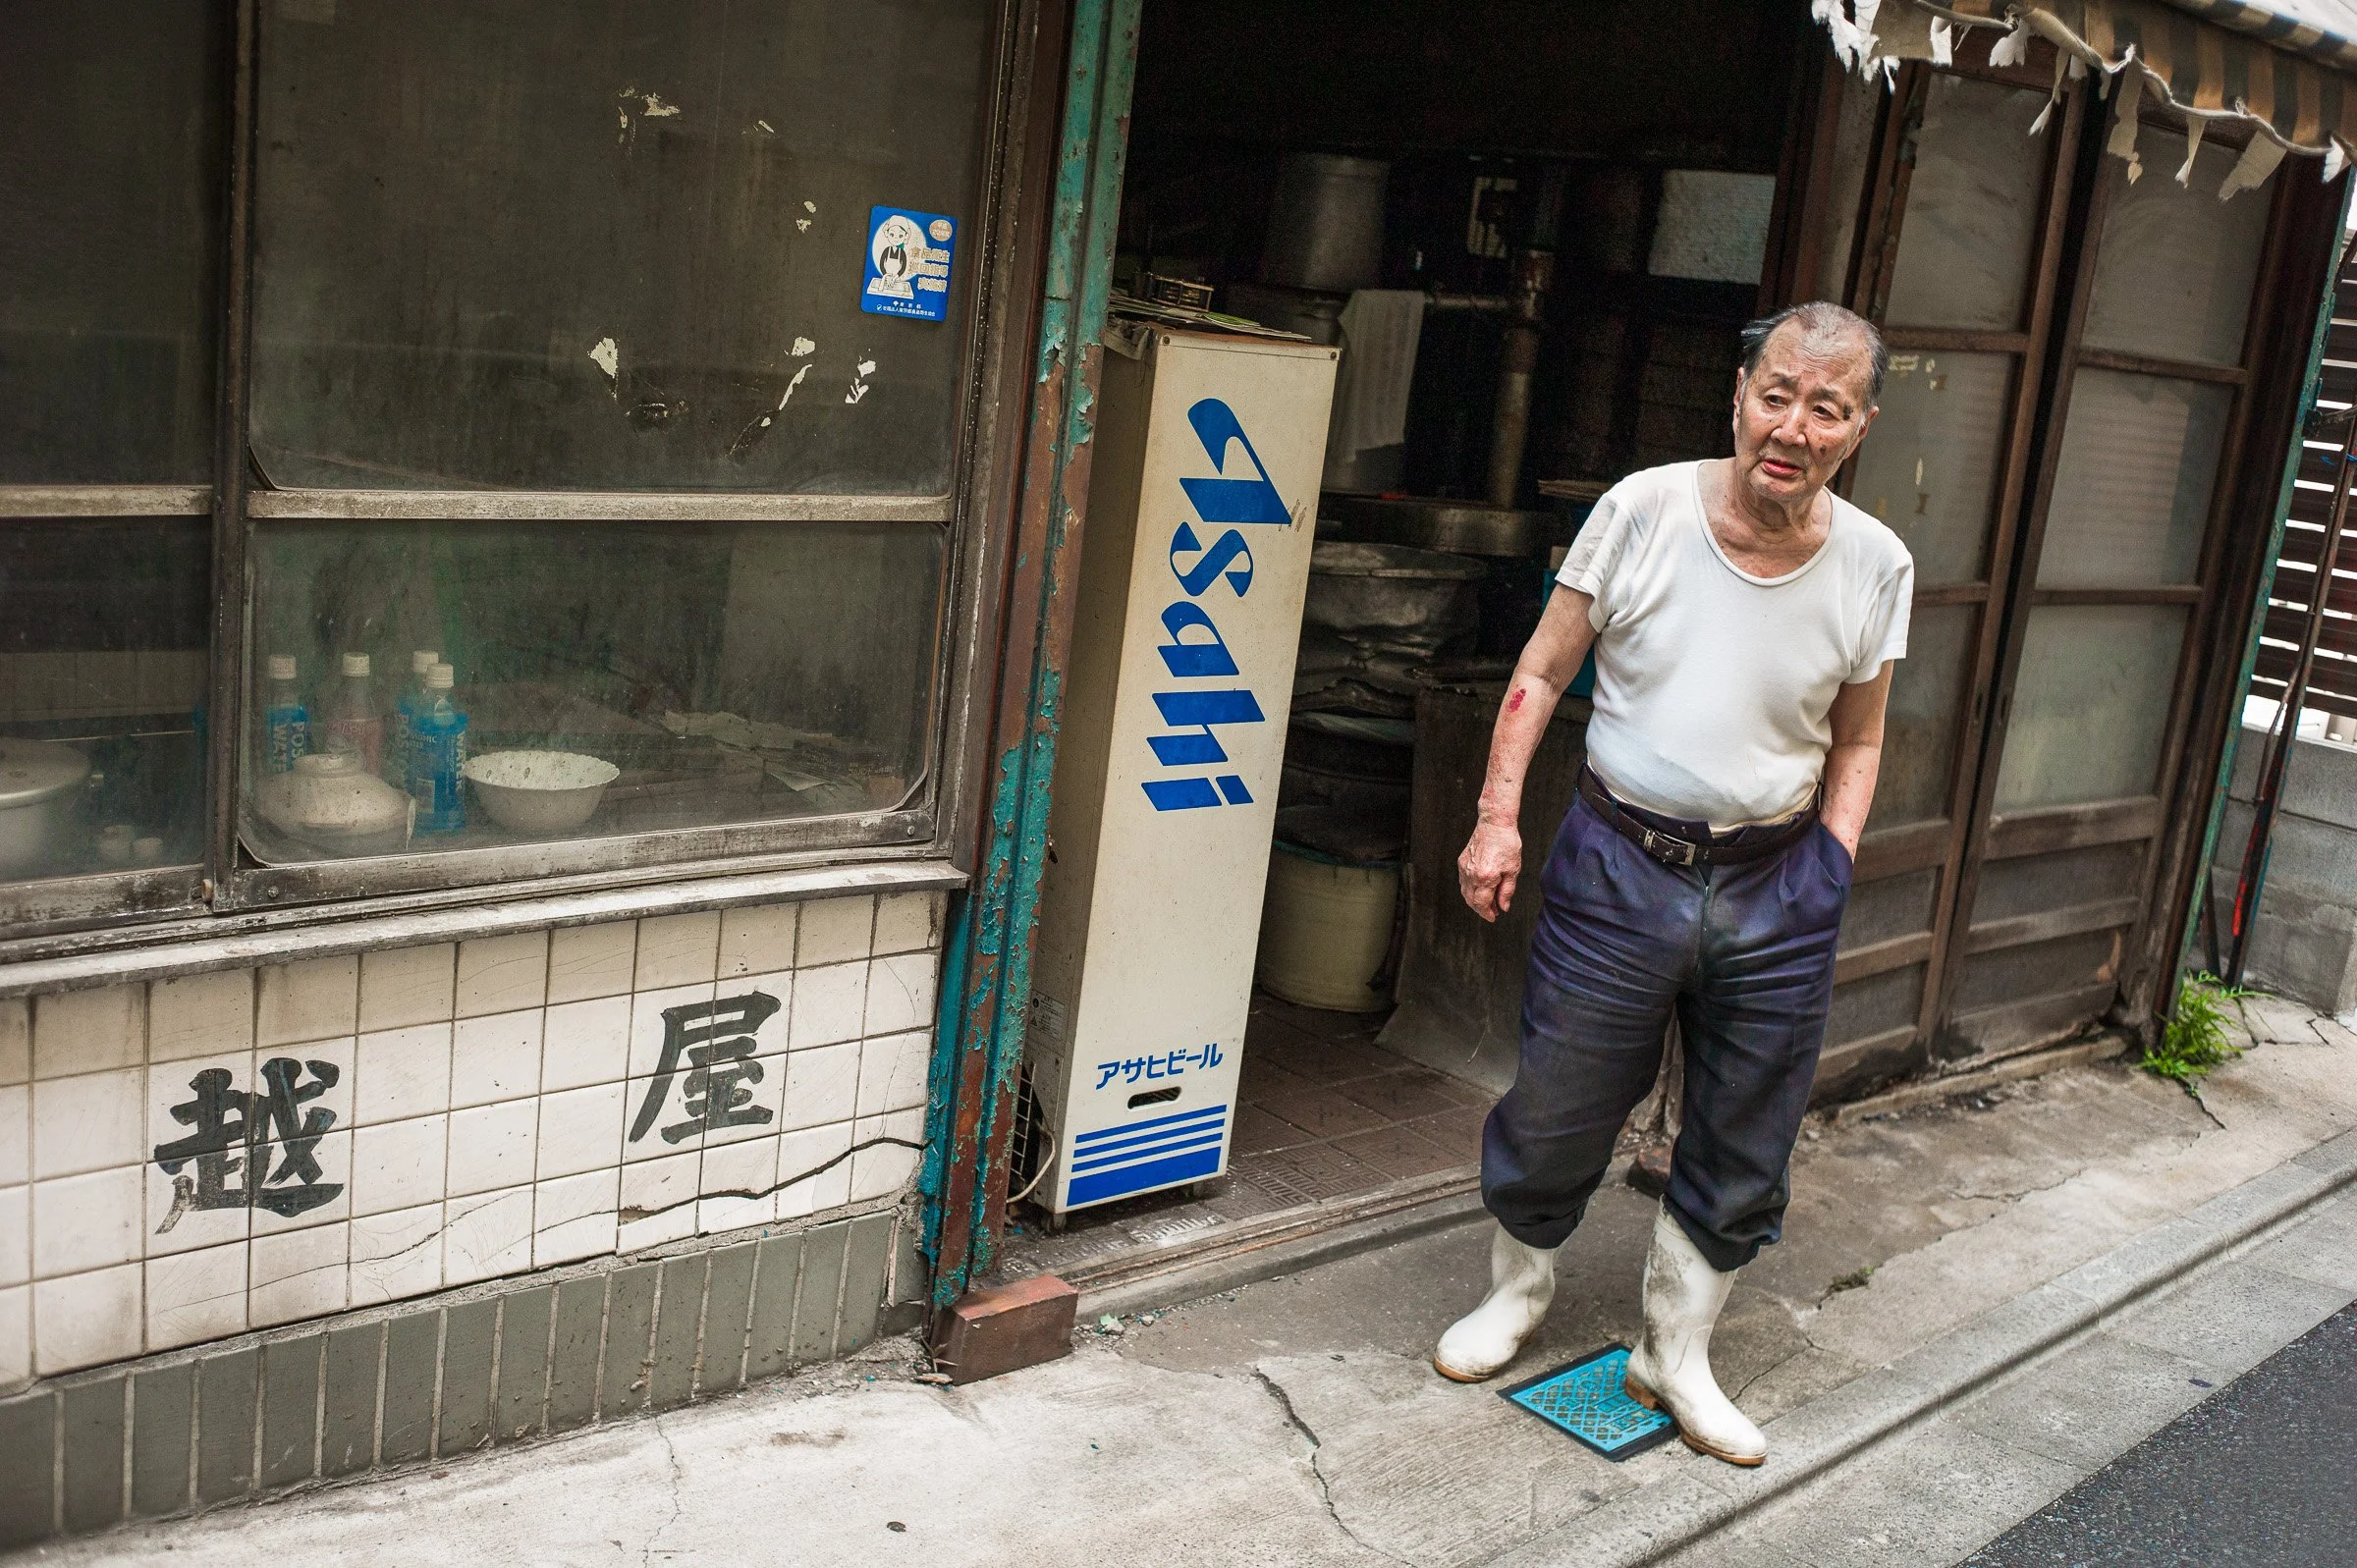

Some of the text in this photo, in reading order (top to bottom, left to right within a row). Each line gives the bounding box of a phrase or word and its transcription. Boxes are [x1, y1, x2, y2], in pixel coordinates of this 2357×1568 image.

[1141, 398, 1291, 812] Asahi
[153, 991, 782, 1235] 越 屋
[1095, 1043, 1224, 1091] アサヒビール
